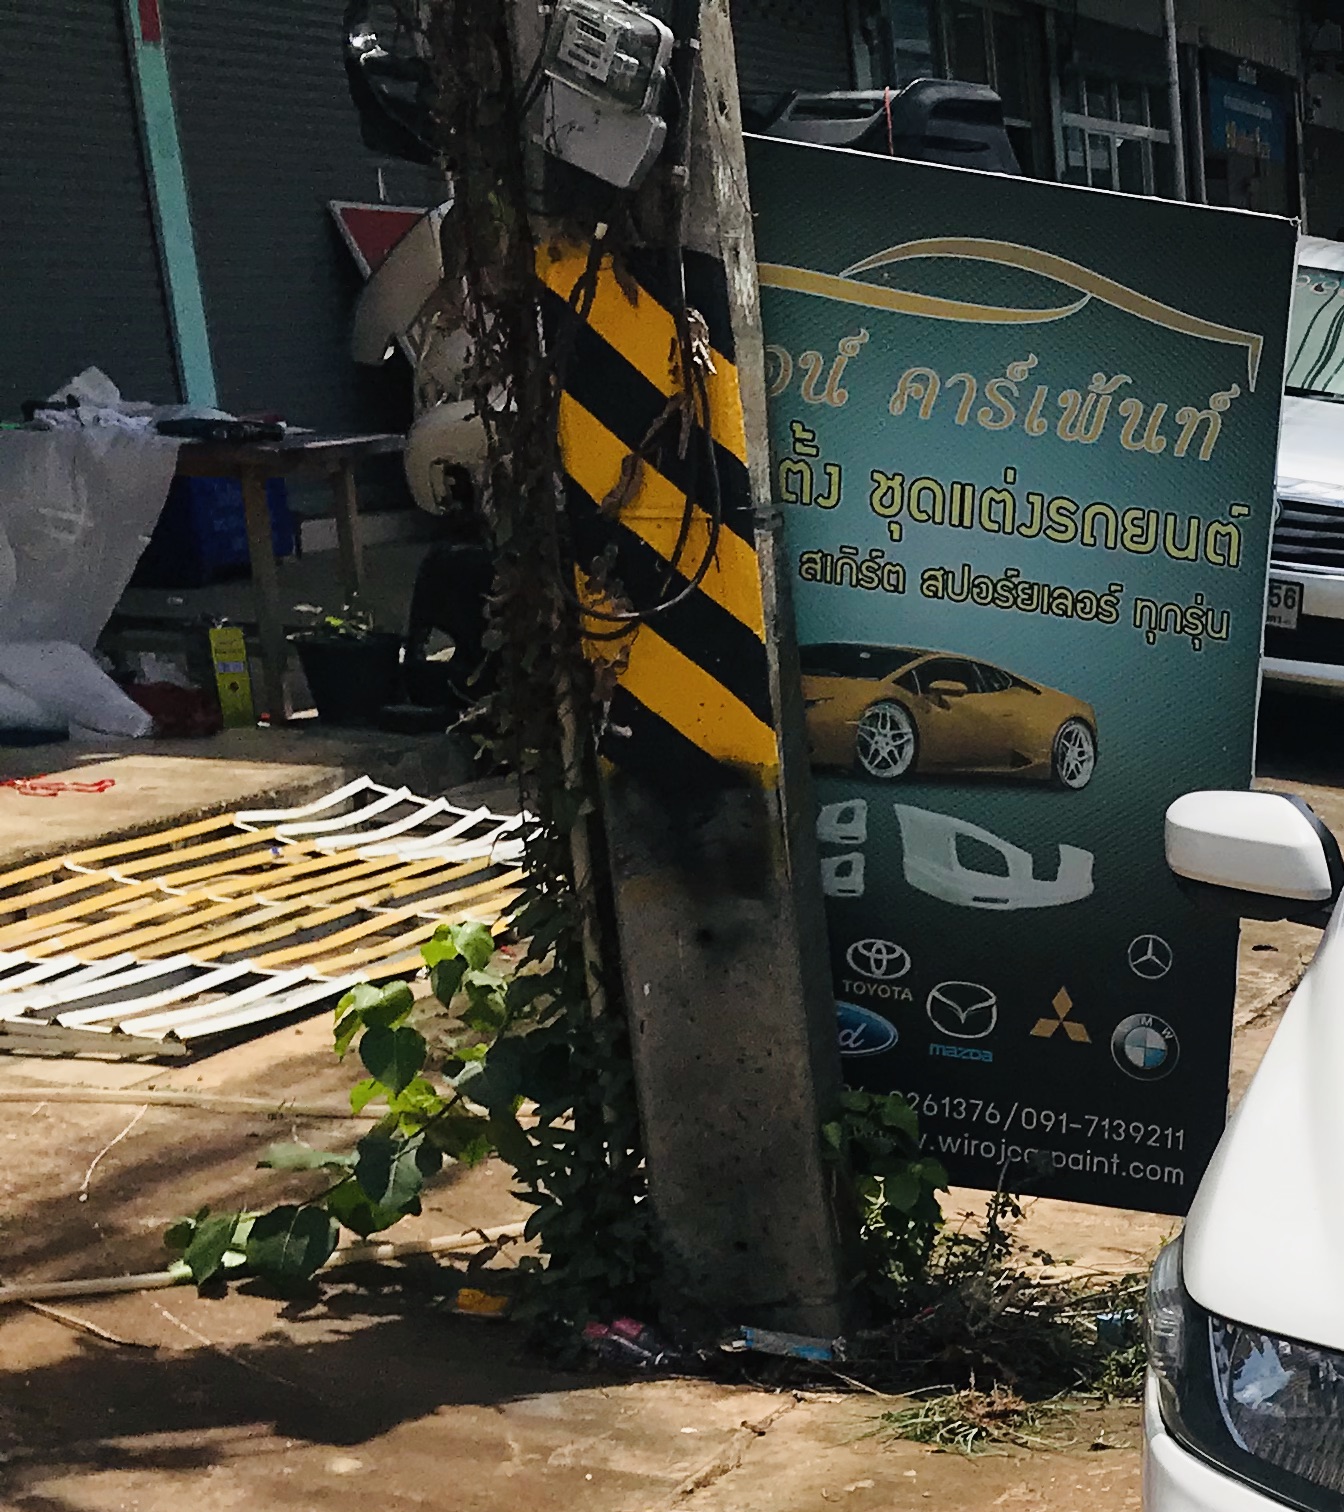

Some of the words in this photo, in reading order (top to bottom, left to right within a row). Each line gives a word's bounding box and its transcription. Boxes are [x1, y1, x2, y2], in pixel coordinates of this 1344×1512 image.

[888, 352, 1241, 461] คาร์เพ้นท์
[778, 420, 842, 510] ตั้ง
[870, 466, 1251, 568] ชุดแต่งรถยนต์
[800, 544, 907, 594] สเกิร์ต
[920, 564, 1124, 625] สปอร์ยเลอร์
[1133, 594, 1231, 650] ทุกรุ่น
[843, 979, 913, 1001] TOYOTA
[929, 1042, 993, 1063] mazda
[889, 1090, 1187, 1151] 261376/091-7139211
[917, 1131, 1186, 1187] .wirojcpaint.com
